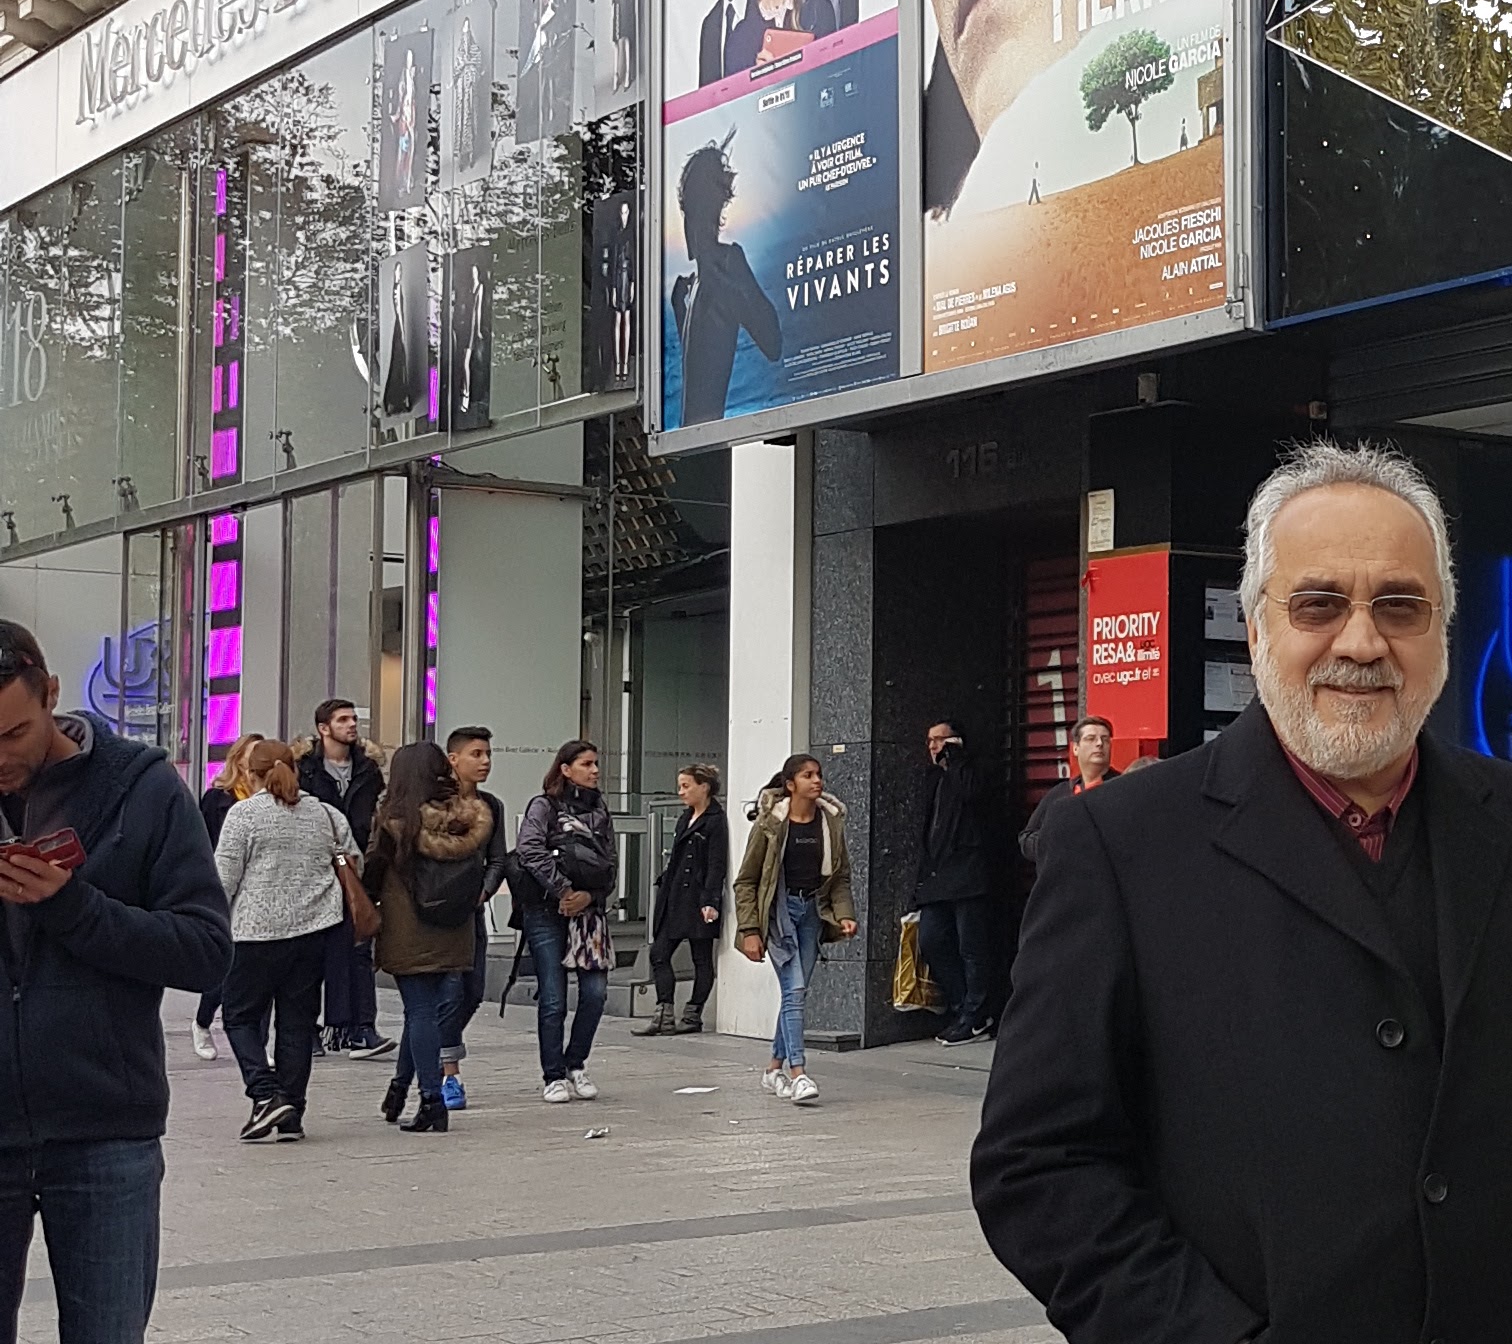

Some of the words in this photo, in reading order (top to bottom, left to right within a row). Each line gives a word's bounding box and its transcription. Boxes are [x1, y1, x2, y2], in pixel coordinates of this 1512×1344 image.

[1125, 58, 1167, 89] NICOLE
[1168, 43, 1222, 74] GARCIA
[832, 132, 865, 154] URGENCE
[1132, 218, 1179, 244] JACQUES
[1181, 206, 1222, 231] FIESCHI
[1140, 236, 1178, 260] NICOLE
[1178, 224, 1222, 249] GARCIA
[786, 243, 855, 280] RÉPARER
[863, 233, 890, 257] LES
[1161, 261, 1189, 281] ALAIN
[1189, 252, 1223, 274] ATTAL
[786, 258, 890, 311] VIVANTS
[1093, 611, 1161, 641] PRIORITY
[1093, 671, 1116, 685] avec
